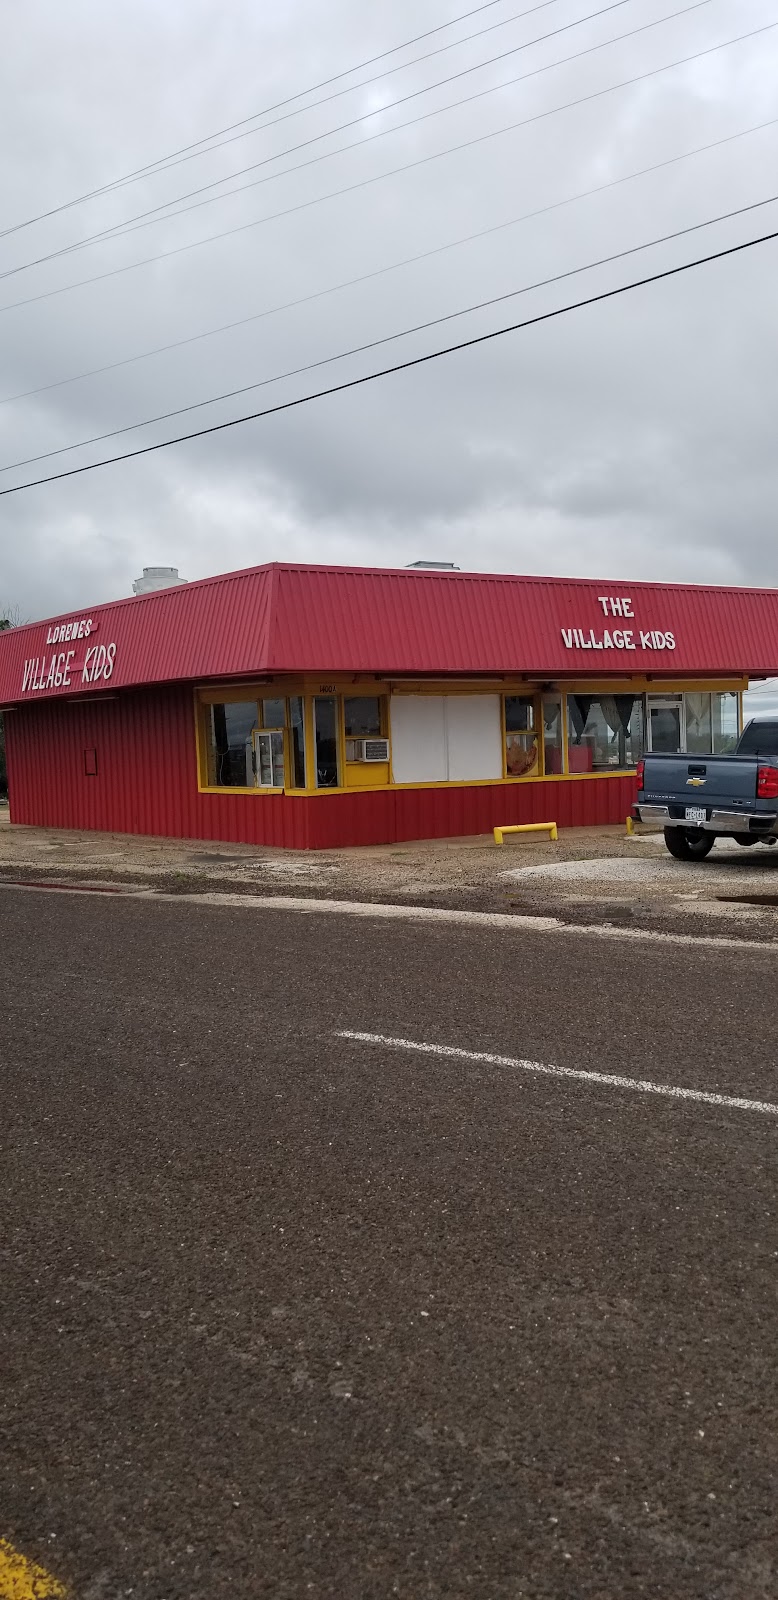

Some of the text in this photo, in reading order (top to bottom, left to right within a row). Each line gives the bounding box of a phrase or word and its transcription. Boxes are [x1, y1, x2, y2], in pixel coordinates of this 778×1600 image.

[597, 596, 635, 618] THE
[46, 618, 93, 645] LORENES
[560, 628, 676, 650] VILLAGE KIDS
[21, 642, 117, 692] VILLAGE KIDS
